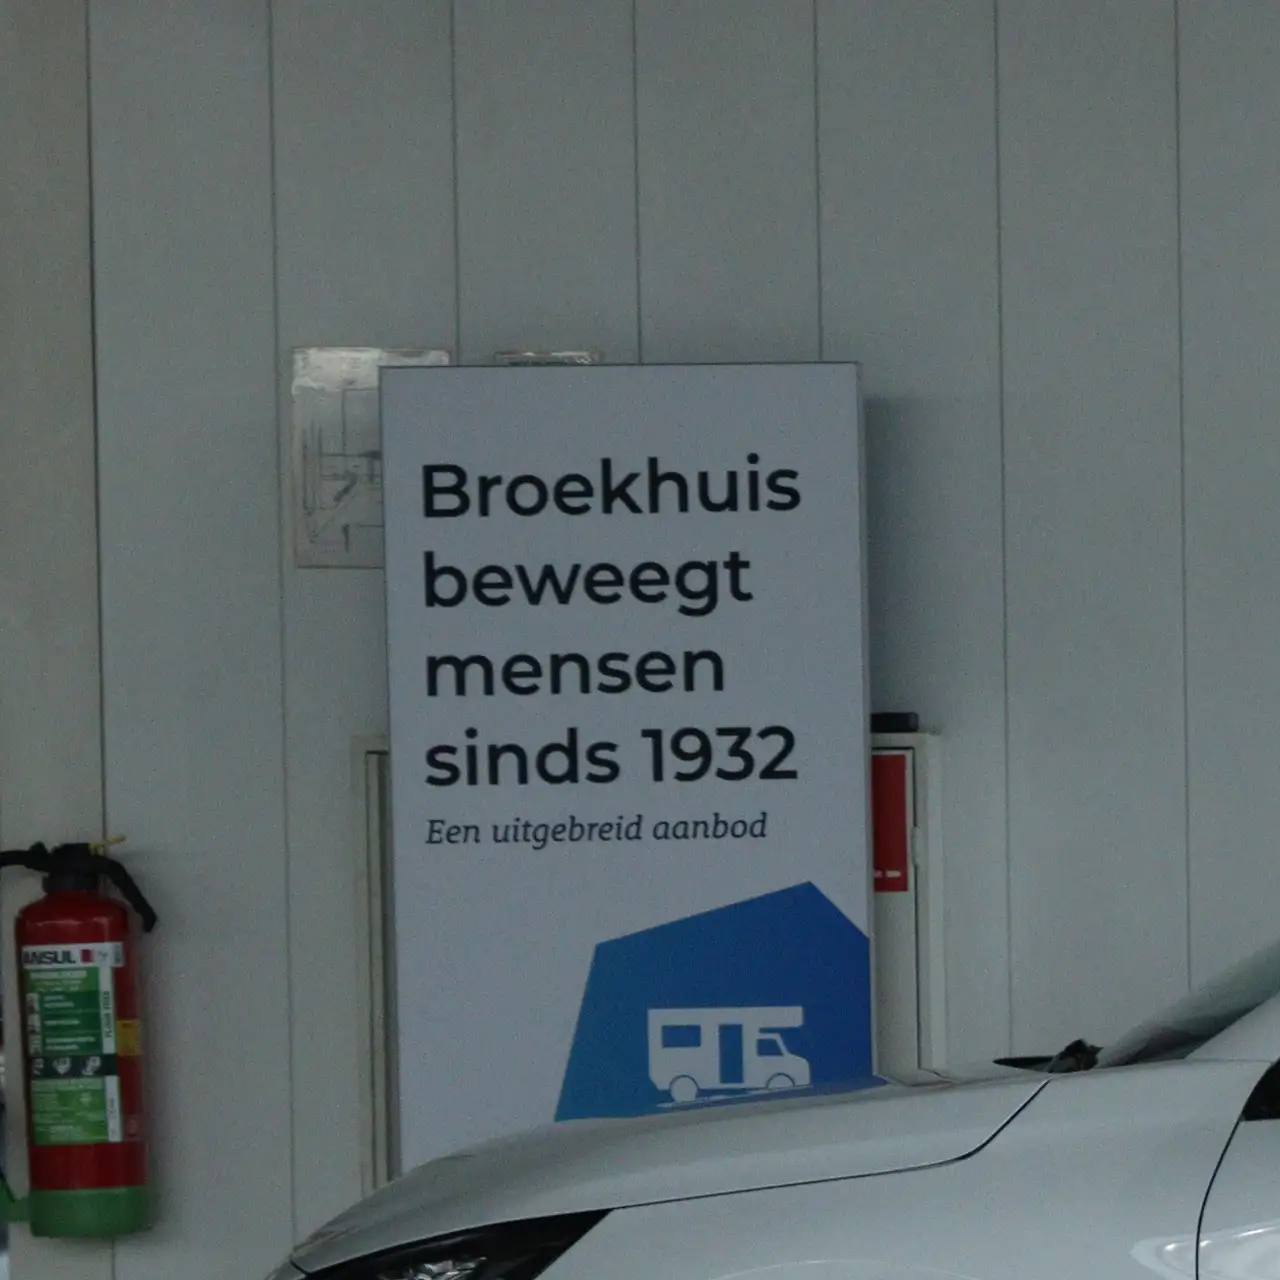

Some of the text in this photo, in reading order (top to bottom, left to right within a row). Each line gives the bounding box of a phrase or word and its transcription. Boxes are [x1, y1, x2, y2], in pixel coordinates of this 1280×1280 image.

[423, 453, 800, 518] Broekhuis
[424, 551, 753, 616] beweegt
[427, 650, 723, 696] mensen
[426, 726, 797, 786] sinds 1932
[426, 811, 767, 850] Een uitgebreid aanbod
